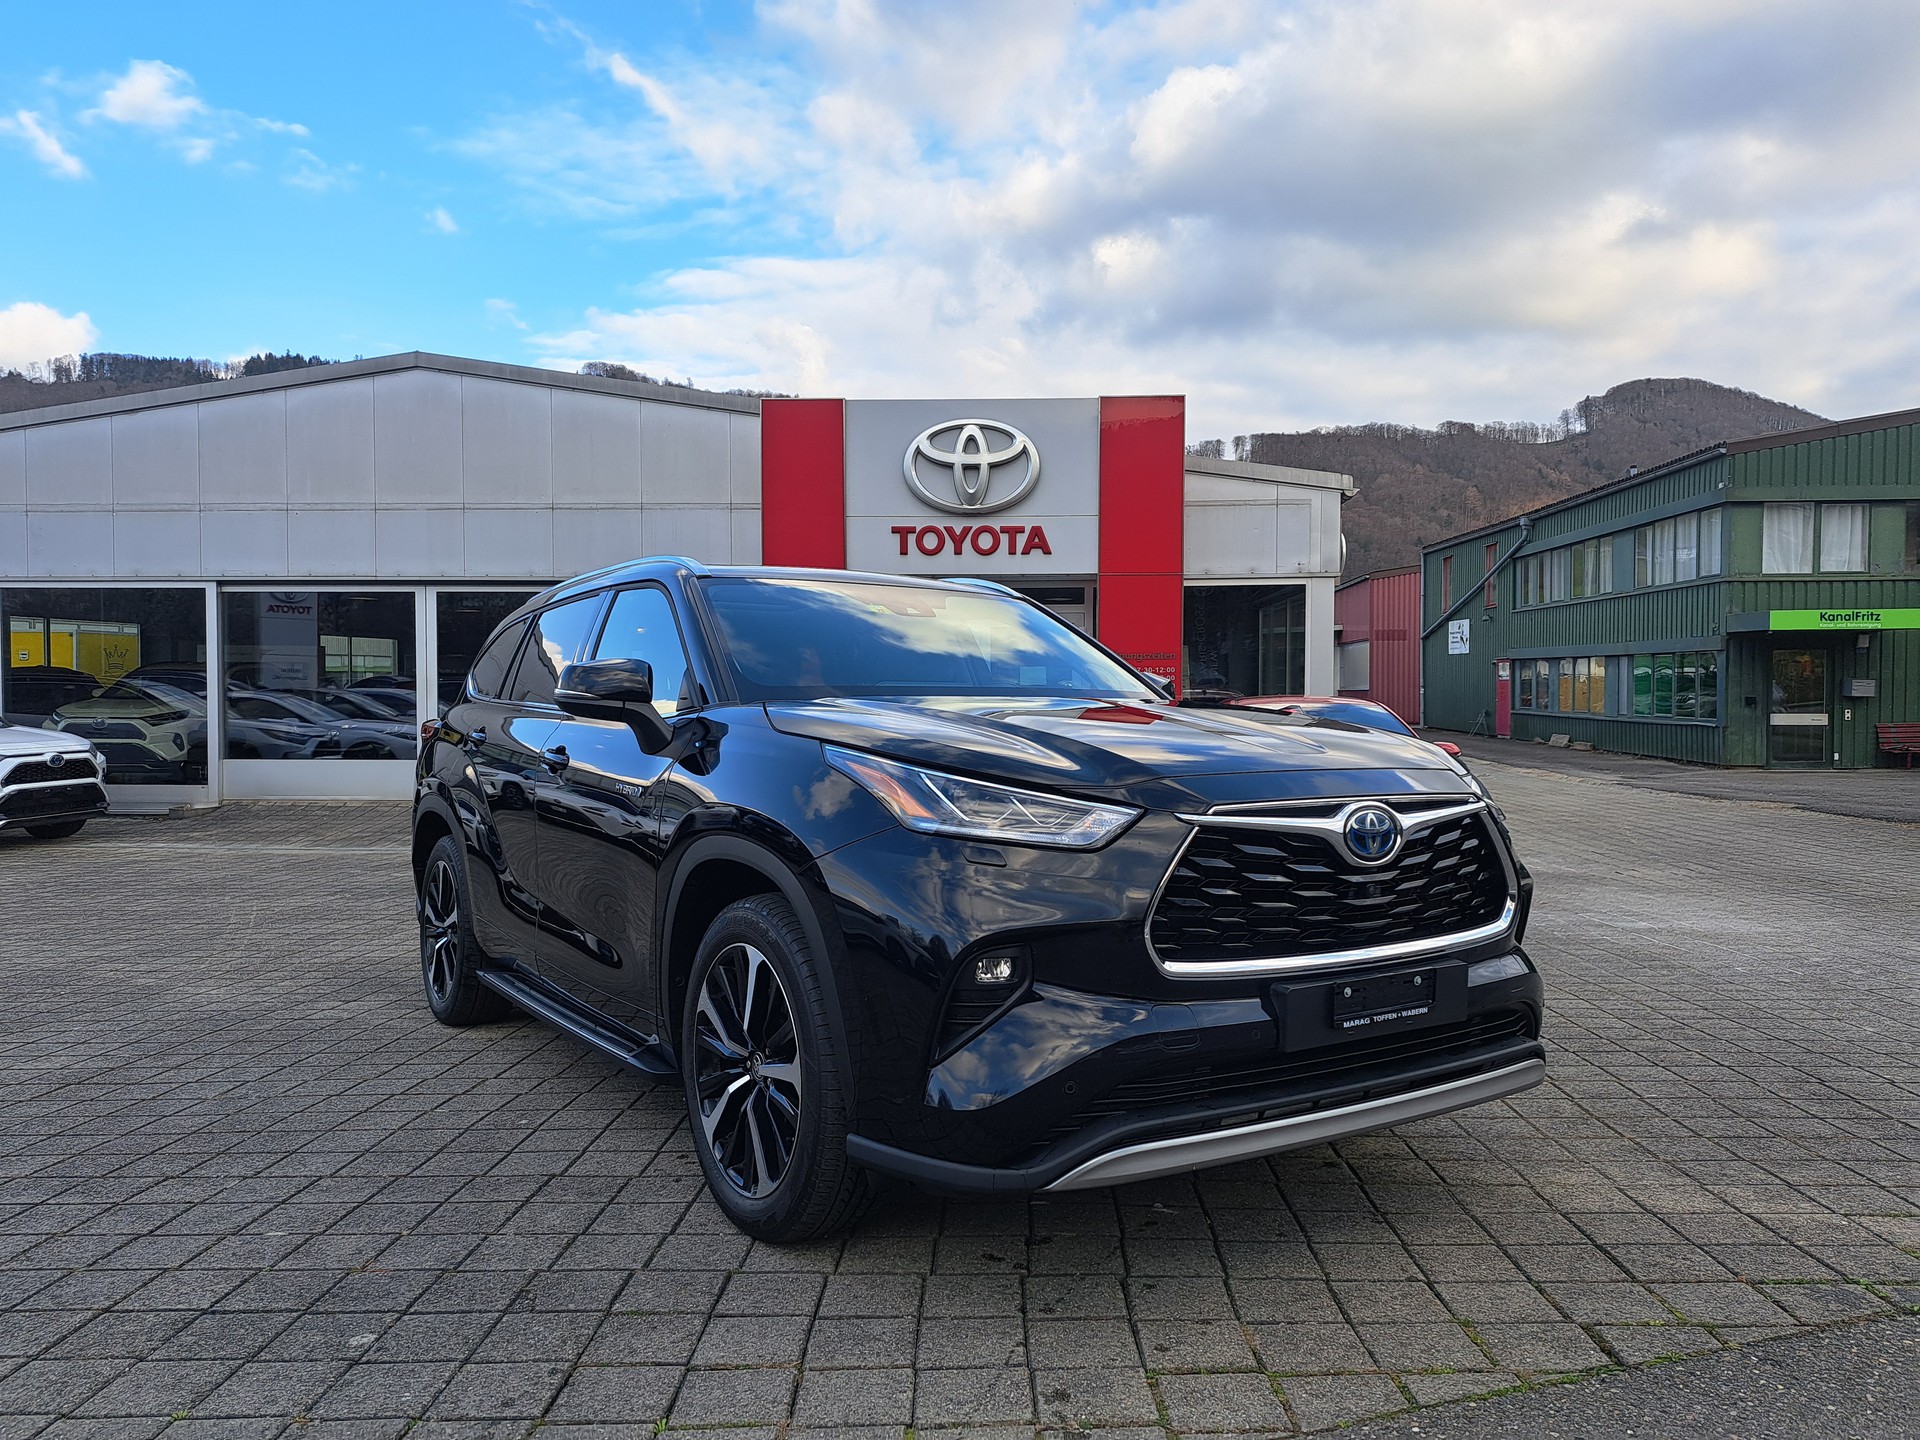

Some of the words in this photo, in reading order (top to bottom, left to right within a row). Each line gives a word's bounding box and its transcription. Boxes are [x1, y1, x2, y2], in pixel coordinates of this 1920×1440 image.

[891, 525, 1052, 556] TOYOTA
[1819, 611, 1881, 621] KanalFritz
[1343, 1018, 1371, 1028] MARAG
[1373, 1012, 1398, 1022] TOFFEN
[1401, 1007, 1428, 1017] WABERN
